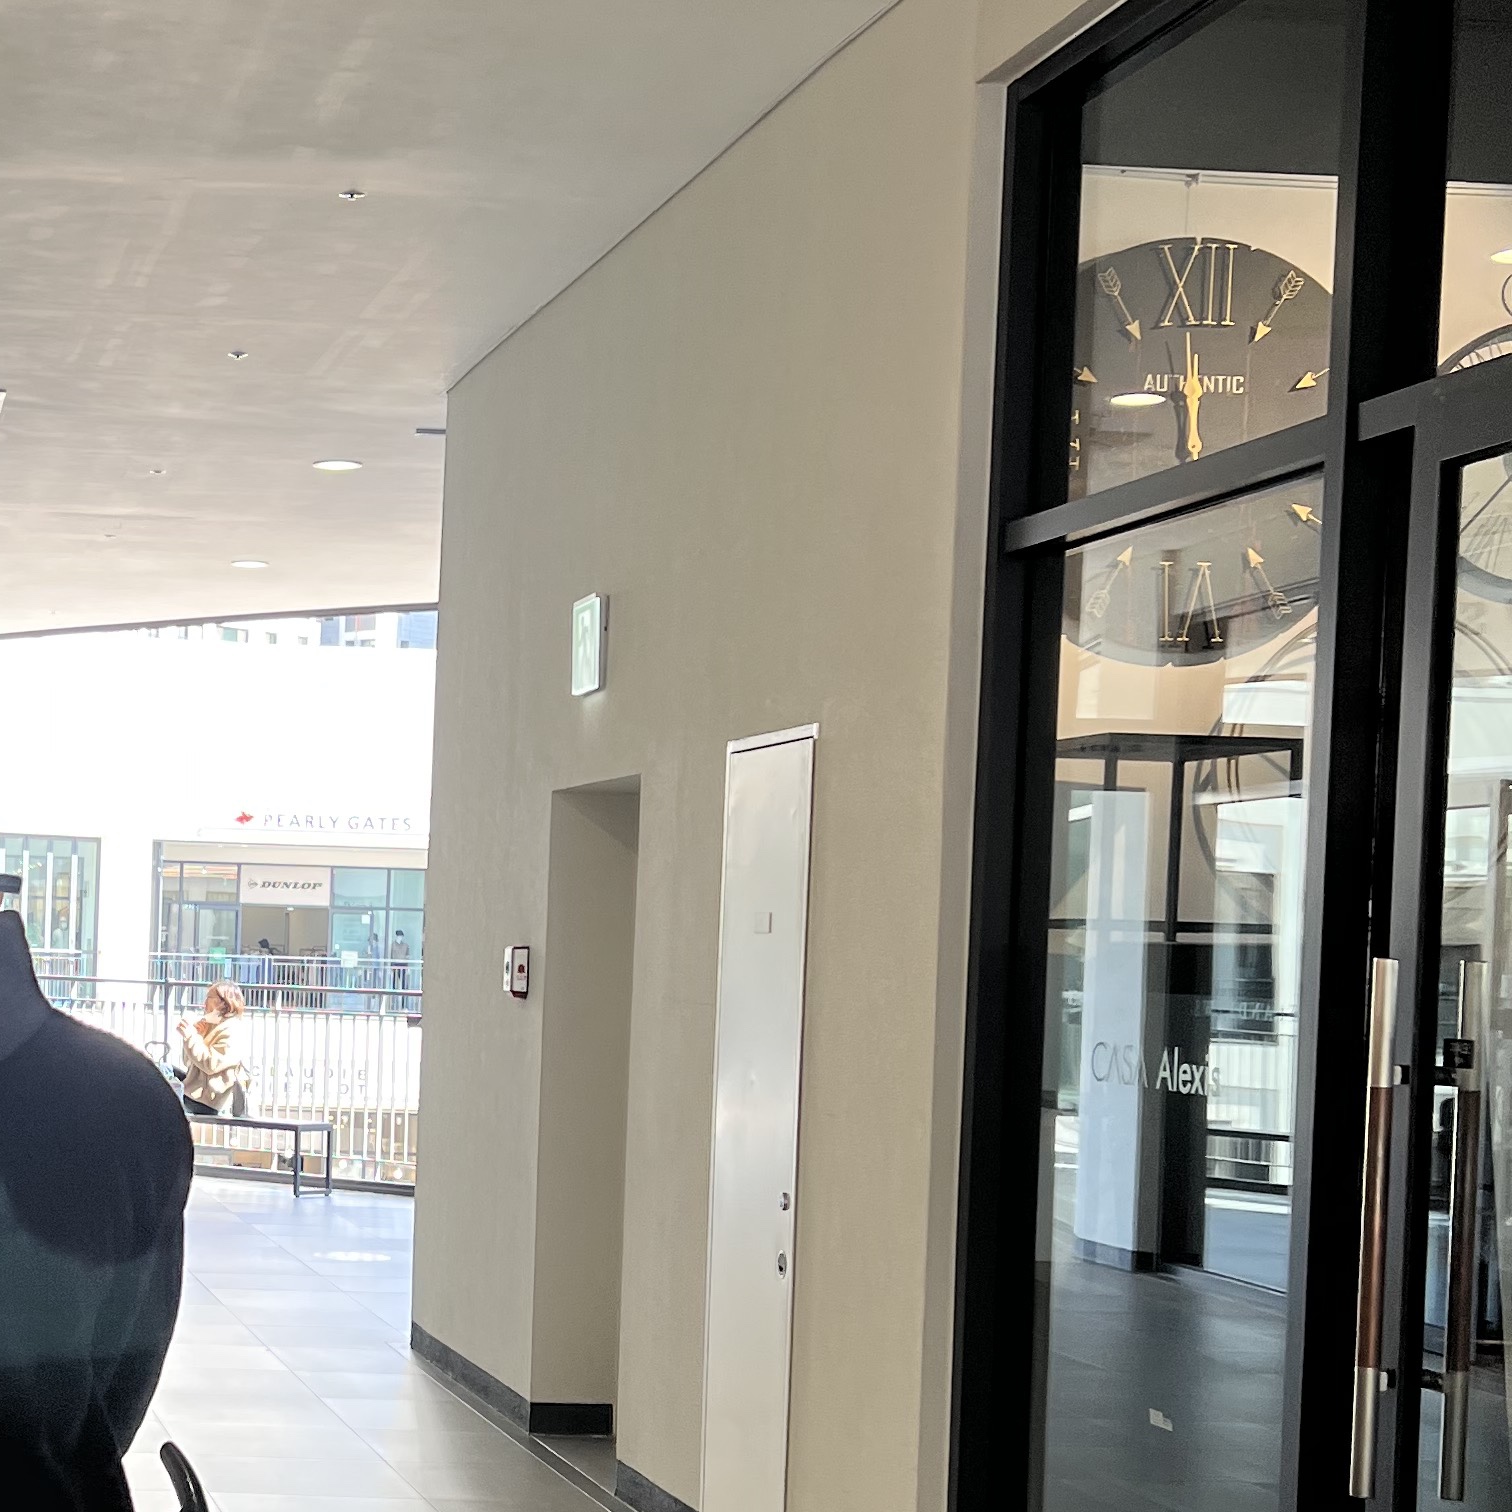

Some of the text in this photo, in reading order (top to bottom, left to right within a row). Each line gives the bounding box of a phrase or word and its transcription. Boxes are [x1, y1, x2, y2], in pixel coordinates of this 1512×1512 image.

[263, 813, 412, 831] PEARLY GATES
[260, 880, 323, 890] DUNLOP
[1155, 1046, 1221, 1098] Alexis
